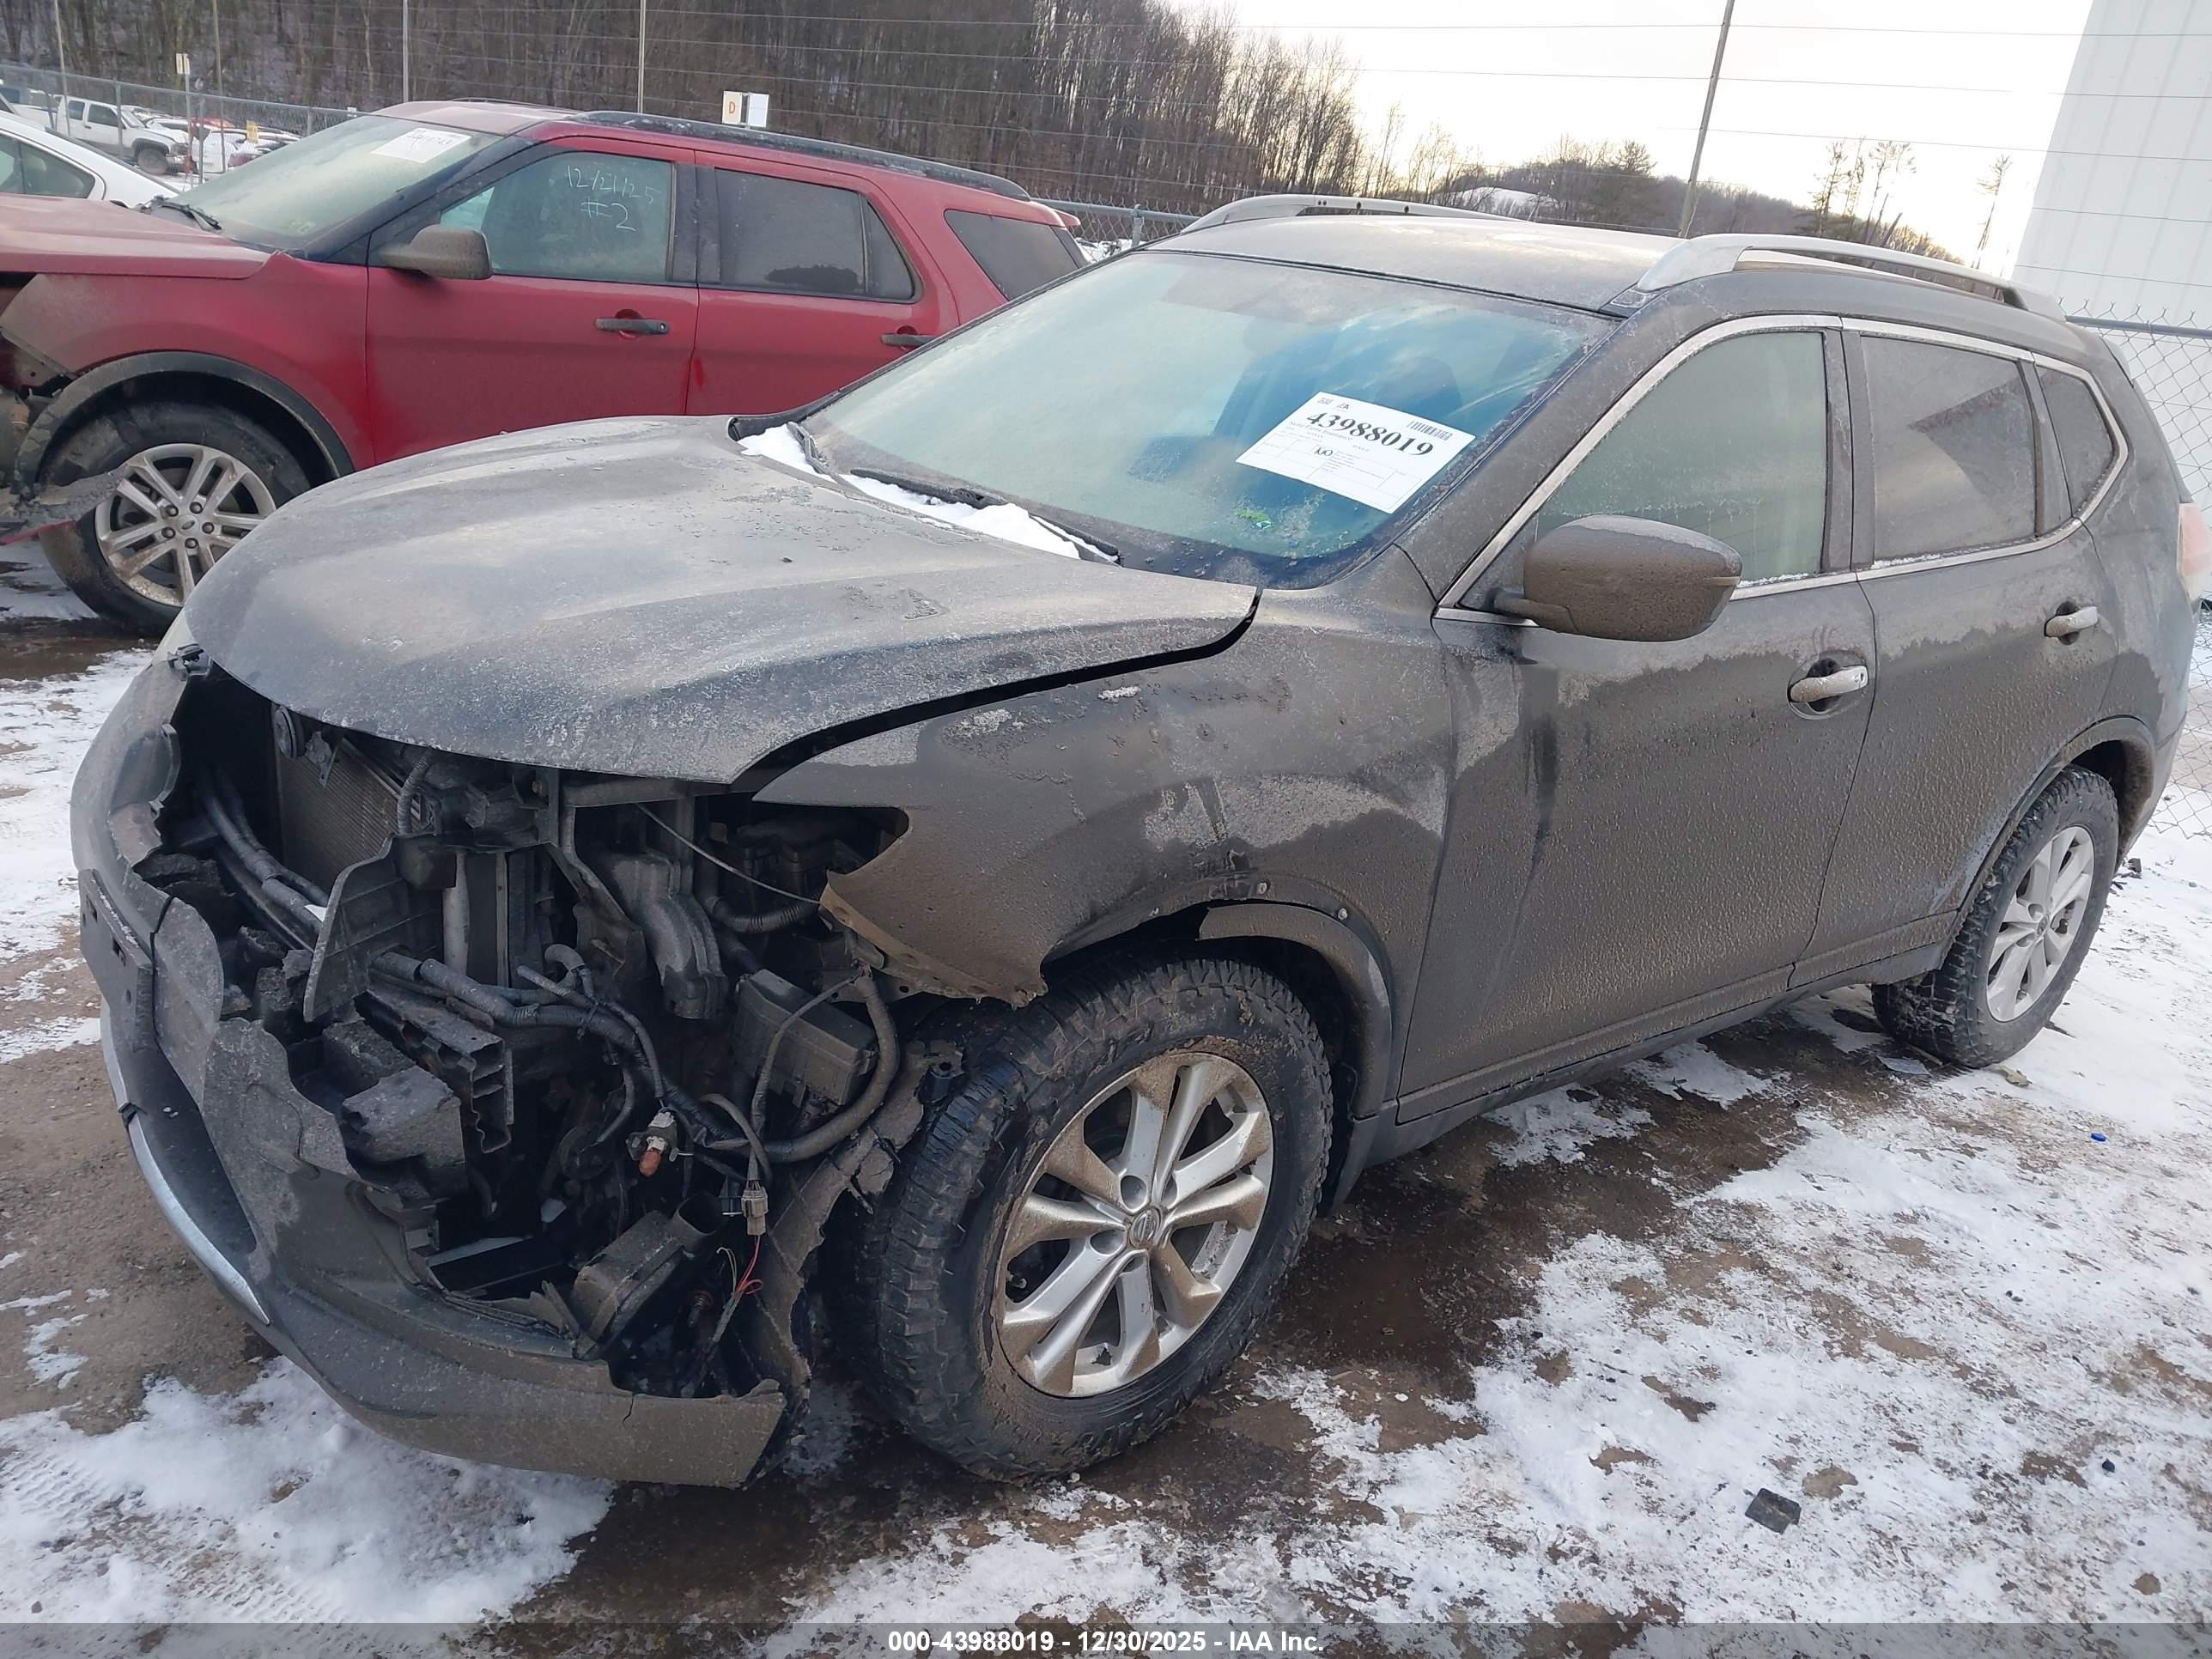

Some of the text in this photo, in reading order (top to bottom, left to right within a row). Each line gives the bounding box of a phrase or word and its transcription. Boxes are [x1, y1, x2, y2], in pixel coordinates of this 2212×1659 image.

[568, 165, 662, 205] 12/21/25
[580, 198, 637, 232] #2
[1306, 412, 1434, 456] 43988019
